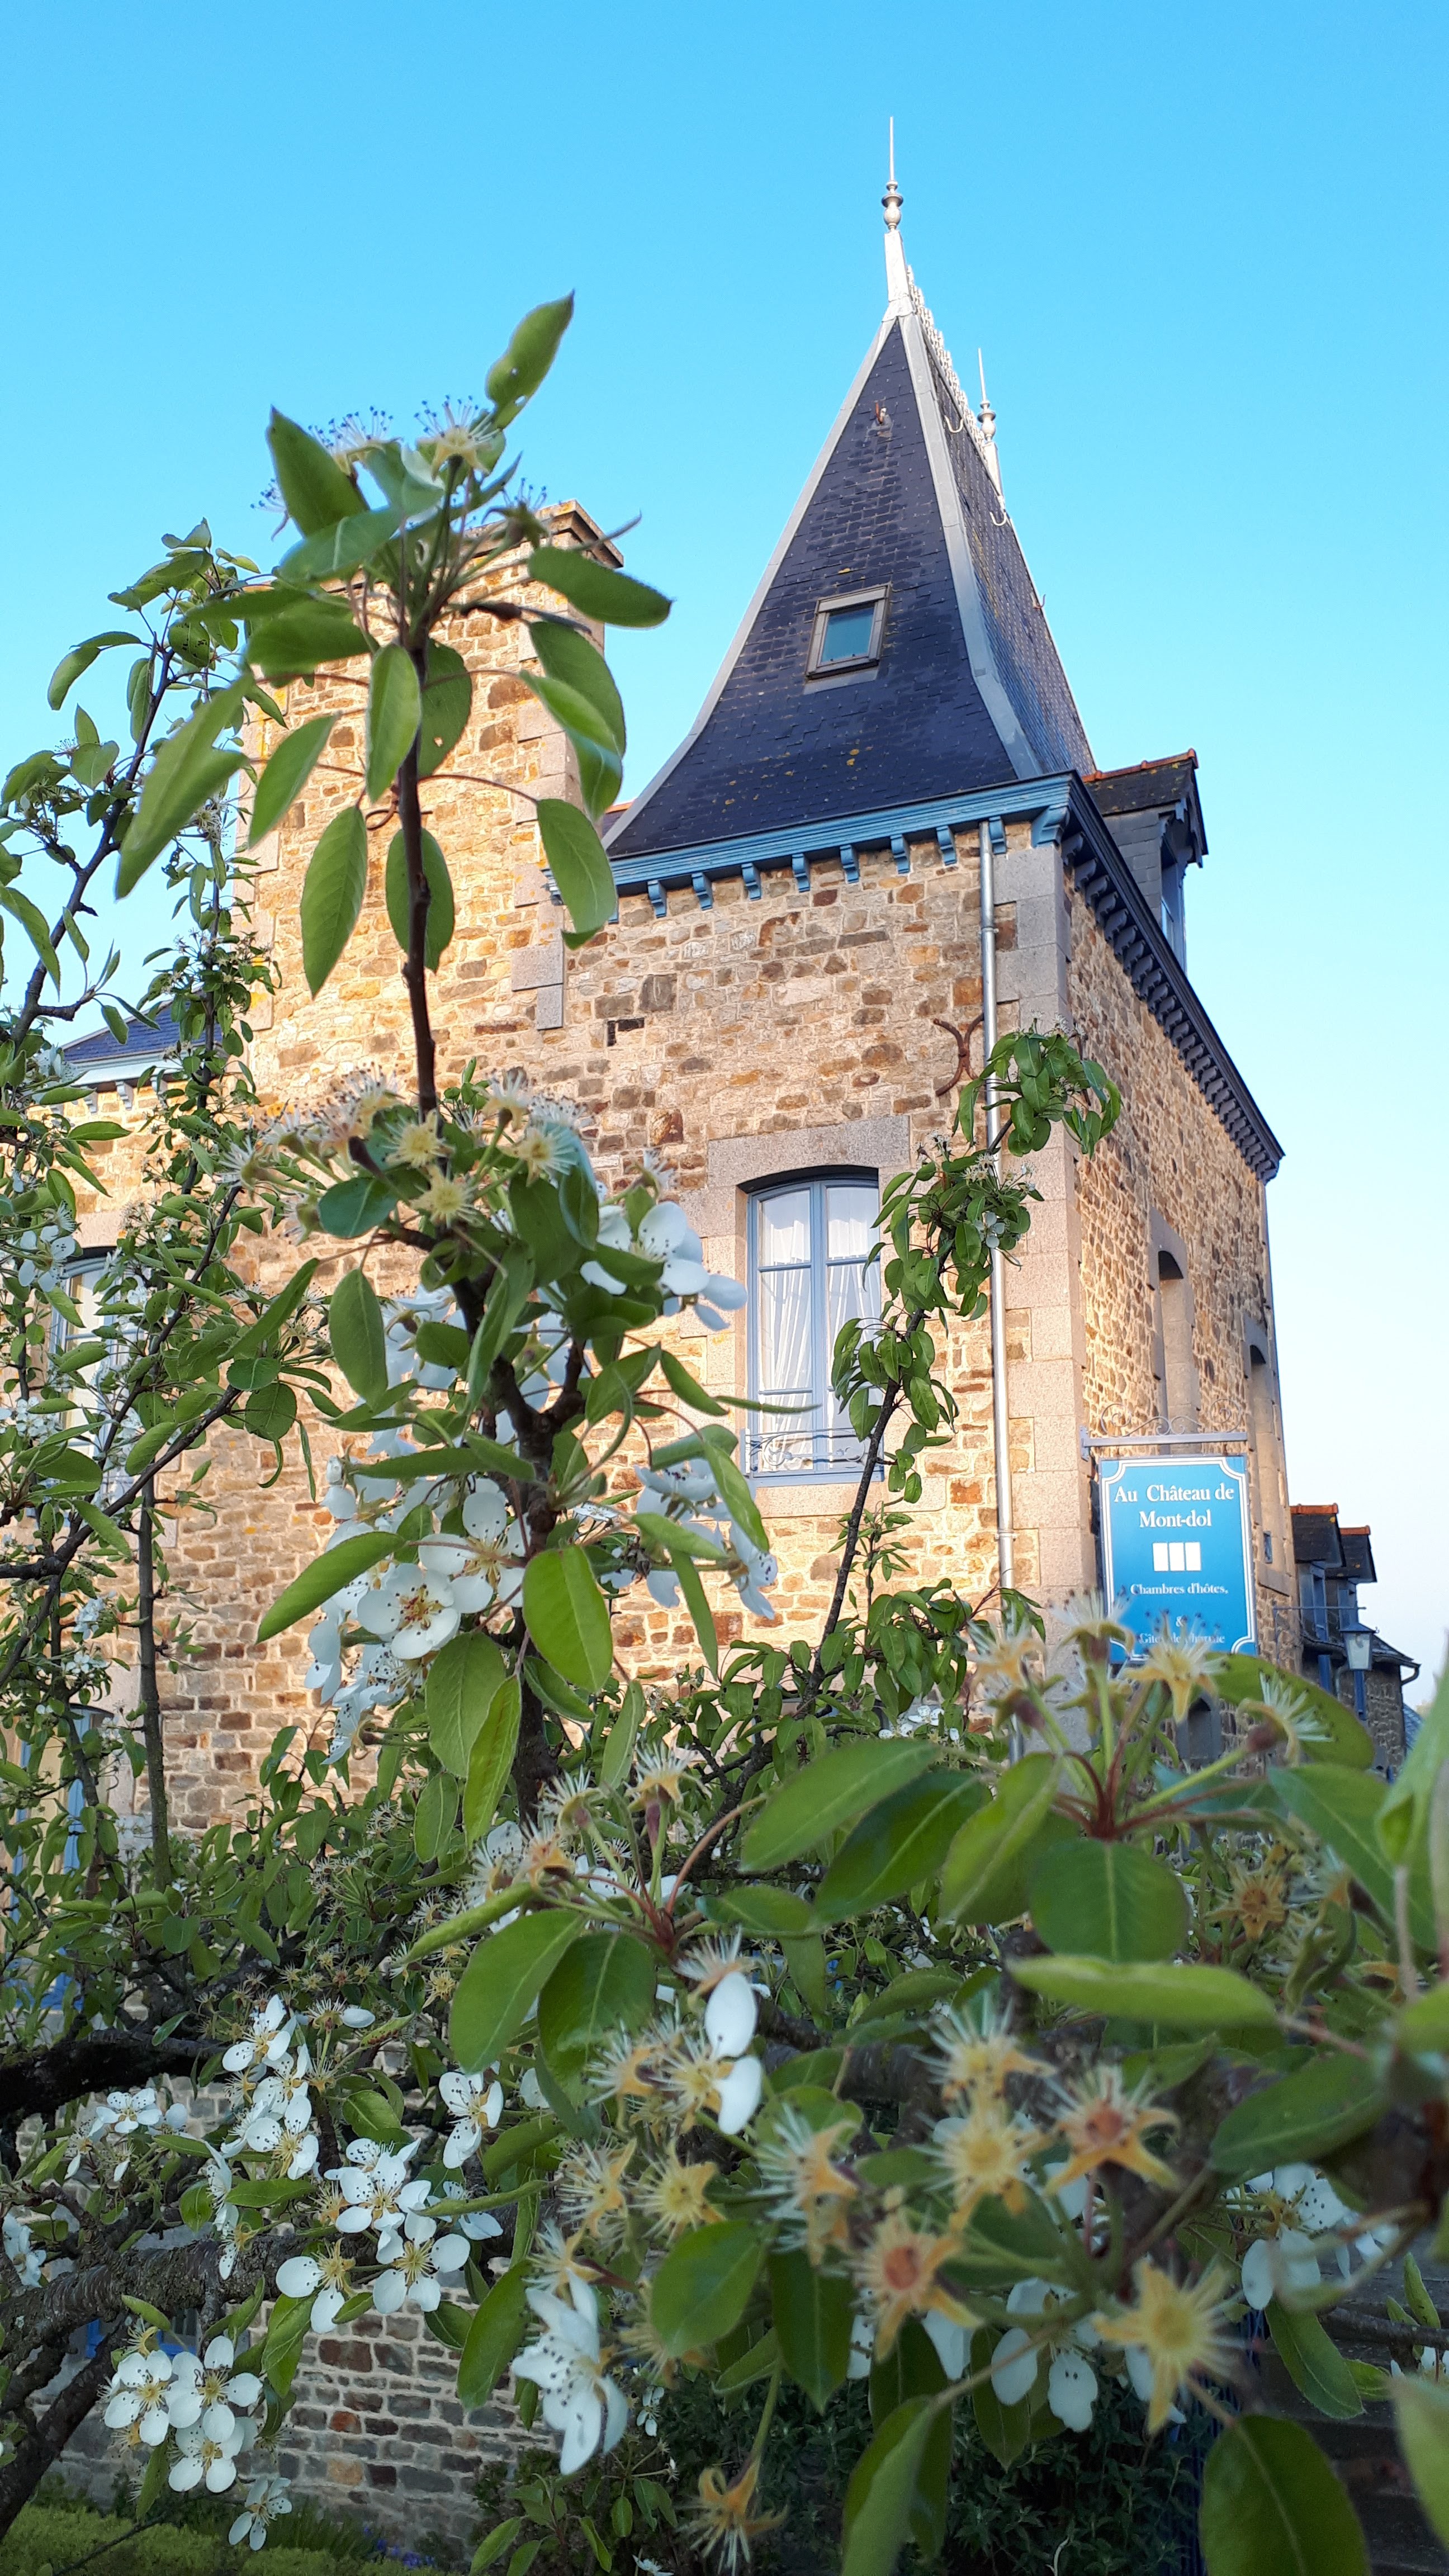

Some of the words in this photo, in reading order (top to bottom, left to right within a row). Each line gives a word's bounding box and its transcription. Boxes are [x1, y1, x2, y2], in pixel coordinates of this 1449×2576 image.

[1114, 1486, 1138, 1503] Au
[1147, 1484, 1211, 1502] Château
[1215, 1482, 1235, 1500] de
[1139, 1509, 1213, 1528] Mont-dol
[1130, 1583, 1185, 1595] Chambres
[1139, 1632, 1164, 1644] Gîte
